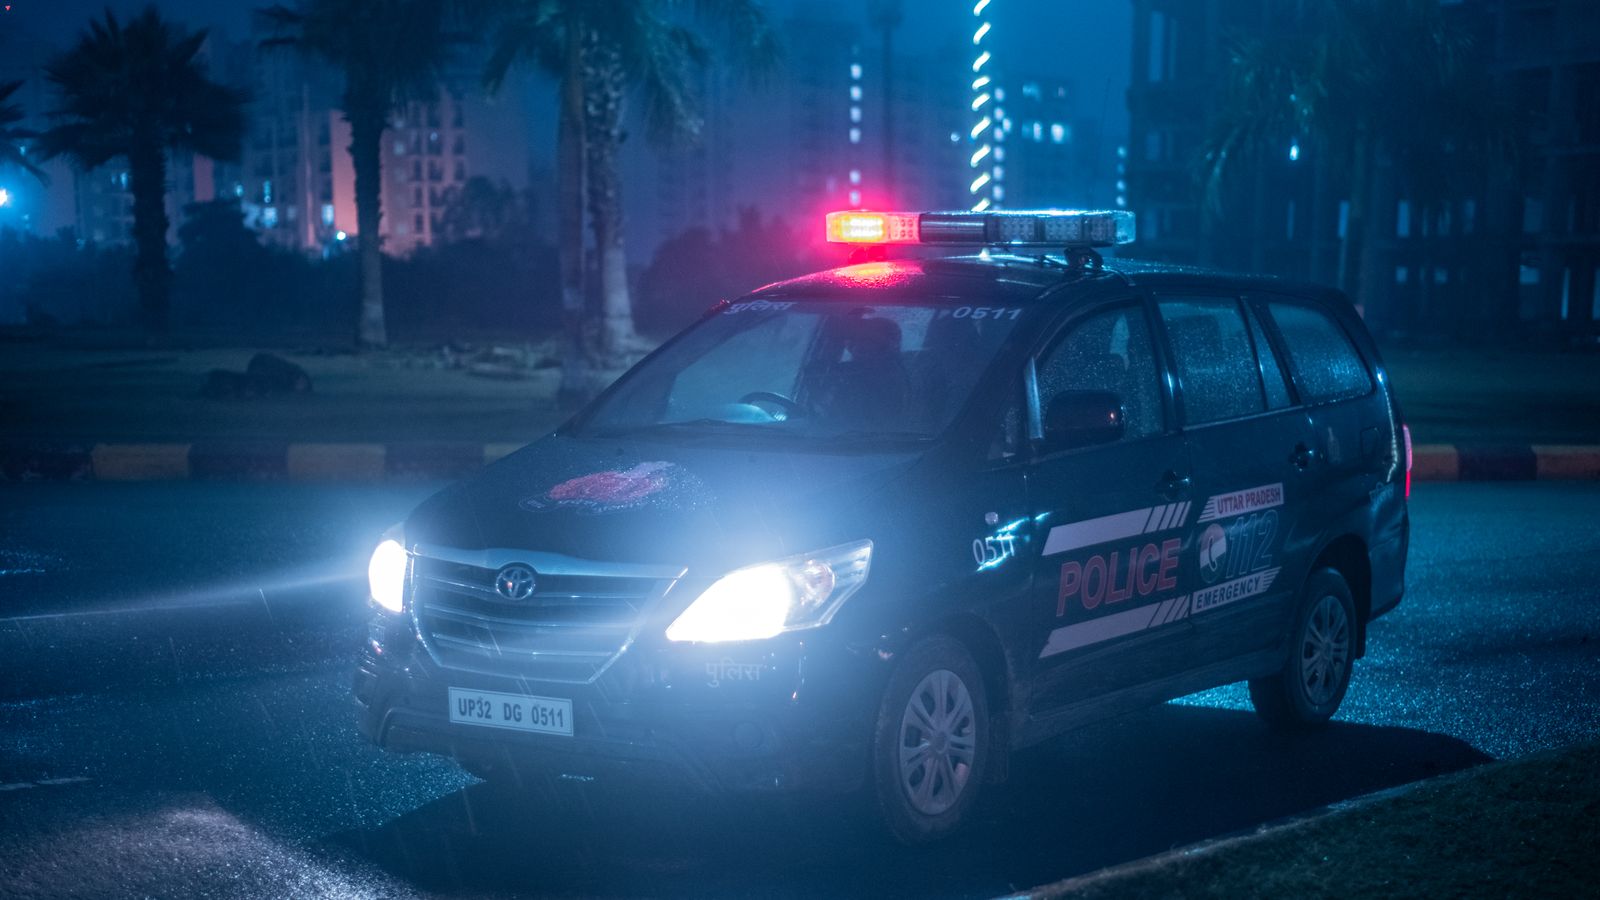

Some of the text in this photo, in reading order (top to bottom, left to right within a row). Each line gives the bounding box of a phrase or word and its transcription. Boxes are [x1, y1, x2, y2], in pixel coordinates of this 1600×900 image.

[723, 300, 797, 315] पुलिस
[952, 306, 1022, 320] 0511
[1217, 487, 1281, 514] UTTAR PRADESH
[973, 532, 1015, 565] 0511
[1226, 509, 1279, 579] 112
[1056, 537, 1182, 617] POLICE
[1196, 577, 1260, 609] EMERGENCY
[705, 656, 763, 688] पुलिस
[458, 698, 563, 727] UP32 DG 0511
